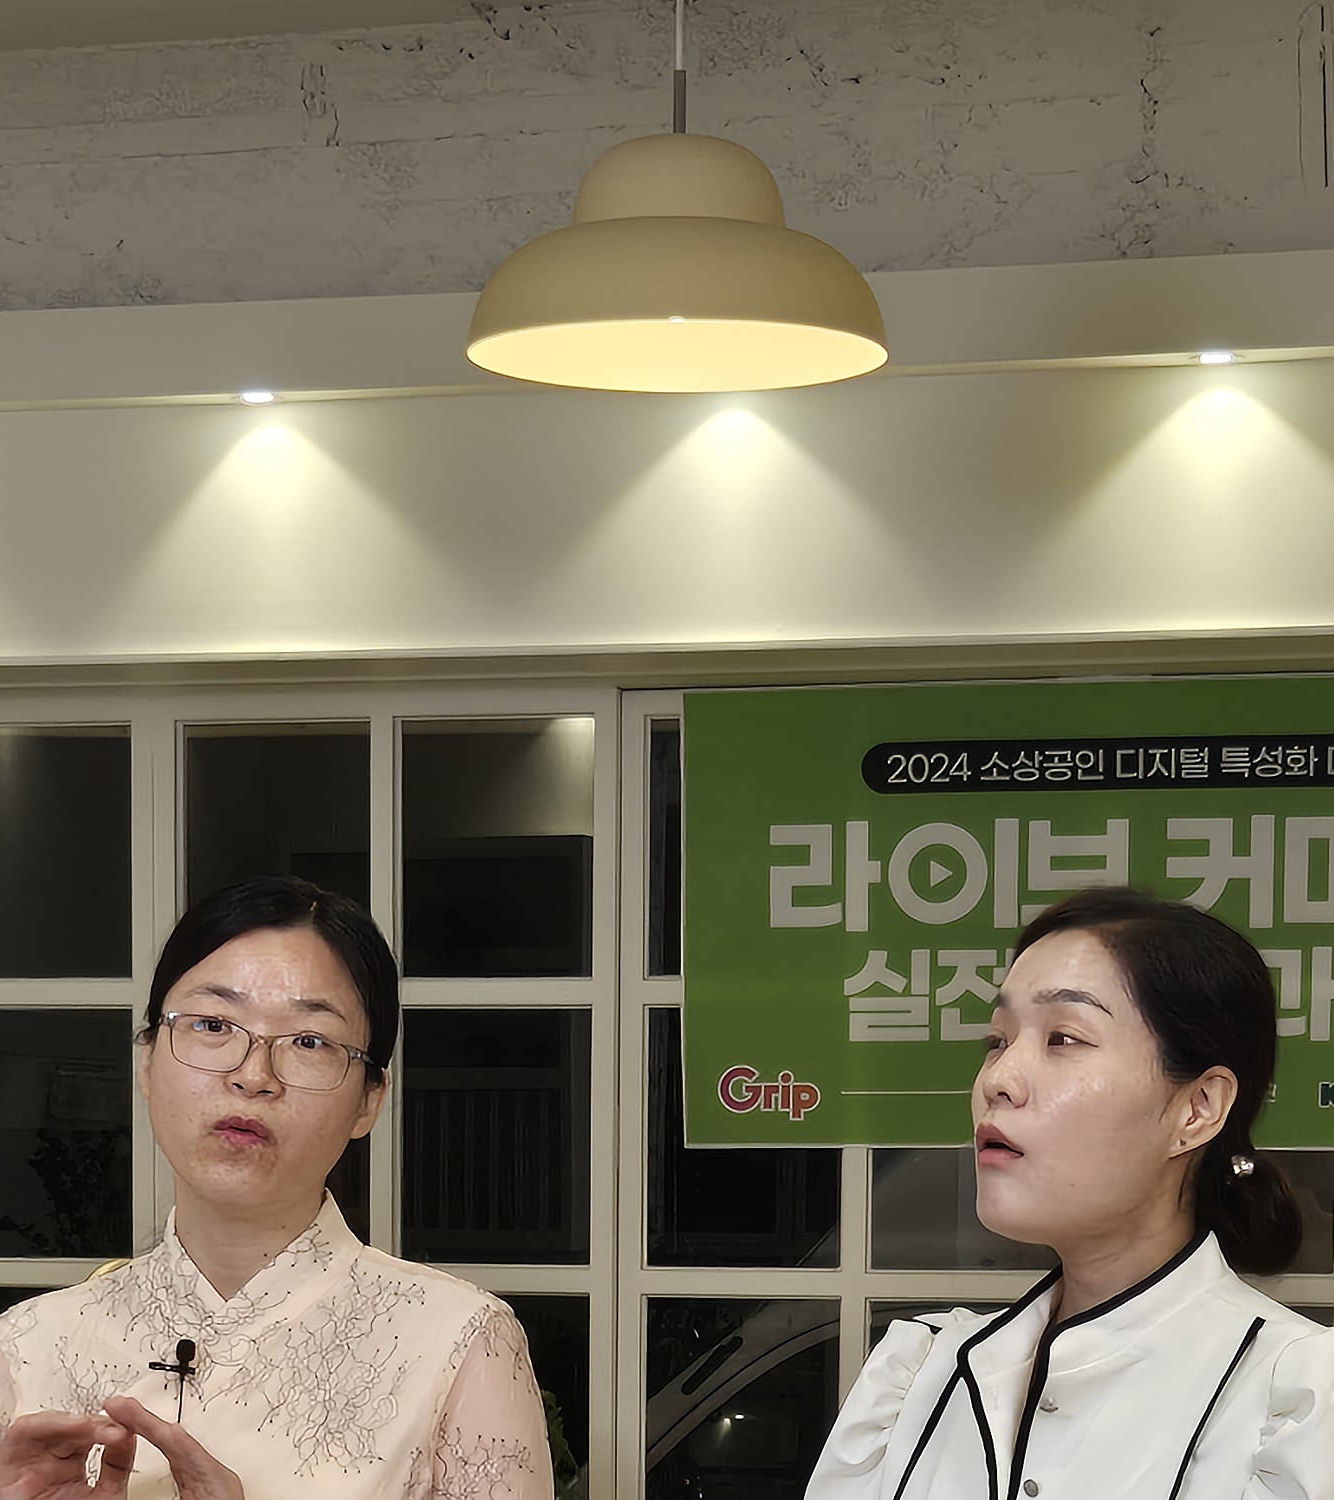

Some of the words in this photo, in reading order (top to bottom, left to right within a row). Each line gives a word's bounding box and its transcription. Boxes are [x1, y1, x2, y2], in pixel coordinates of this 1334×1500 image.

[886, 752, 972, 784] 2024
[979, 748, 1105, 782] 소상공인
[1115, 747, 1210, 780] 디지털
[1219, 745, 1319, 779] 특성화
[769, 817, 1130, 932] 라이브
[718, 1065, 822, 1121] Grip
